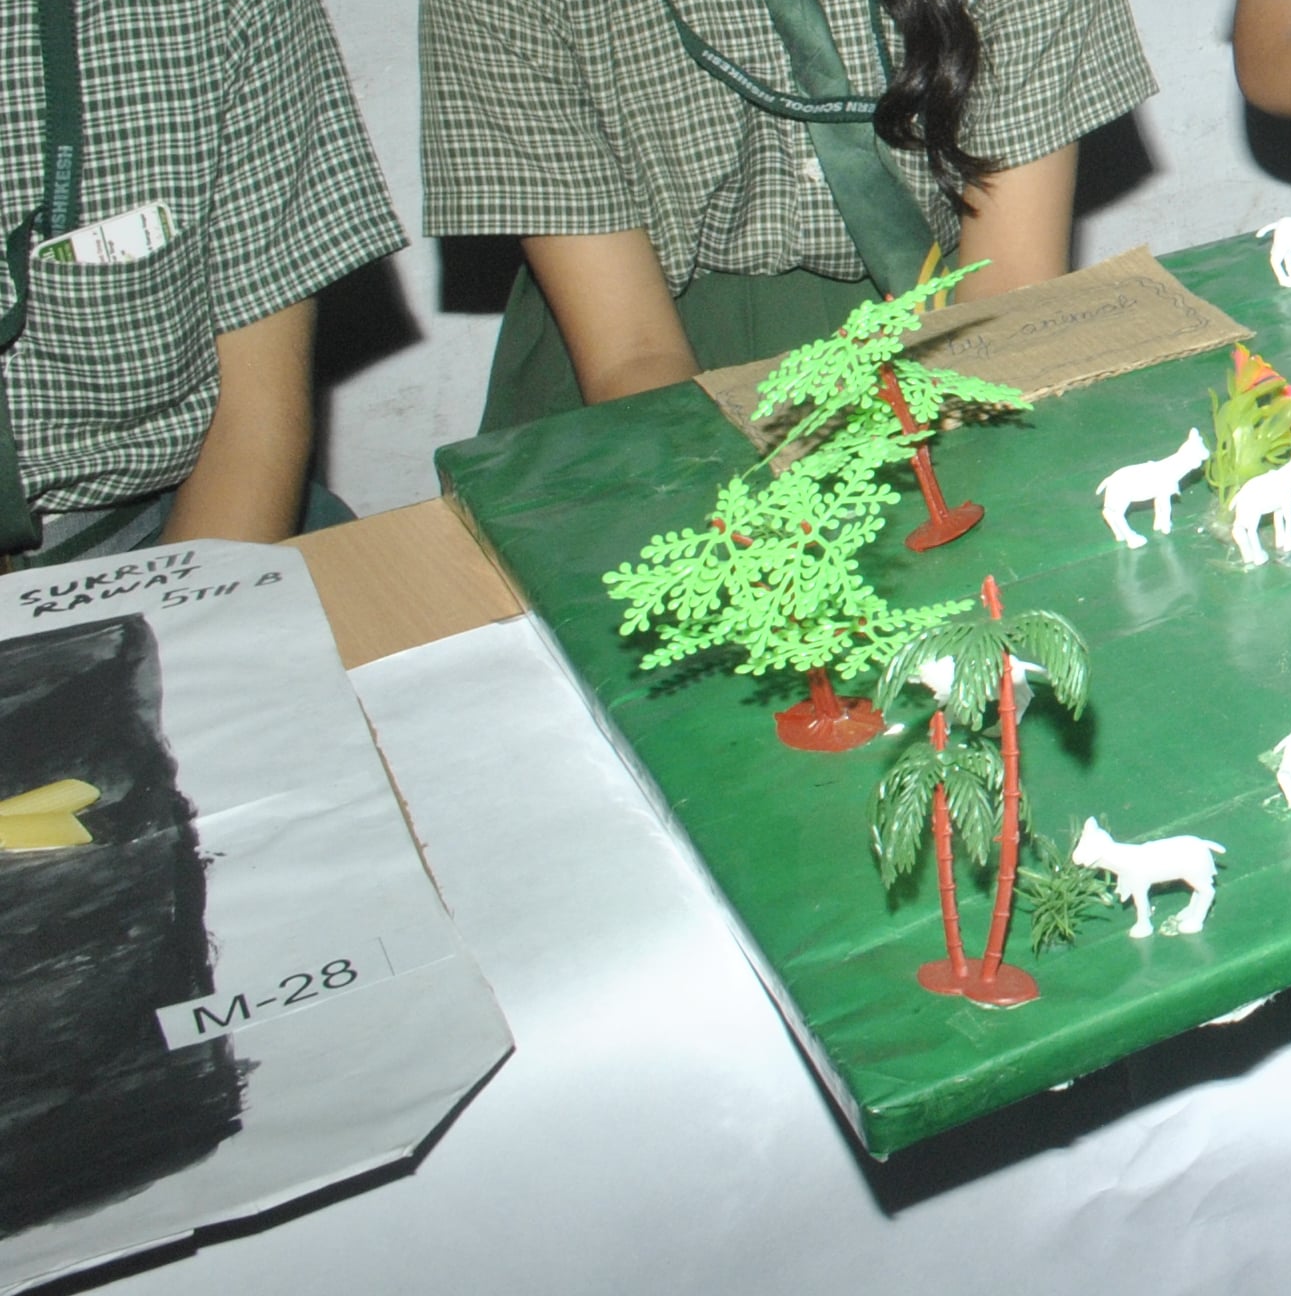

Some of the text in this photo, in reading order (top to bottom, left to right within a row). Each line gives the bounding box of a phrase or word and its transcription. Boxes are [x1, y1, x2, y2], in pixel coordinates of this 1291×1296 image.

[20, 551, 196, 606] SUKRITI
[33, 565, 202, 617] RAWAT
[161, 571, 283, 609] 5TH B
[192, 958, 358, 1035] M-28
